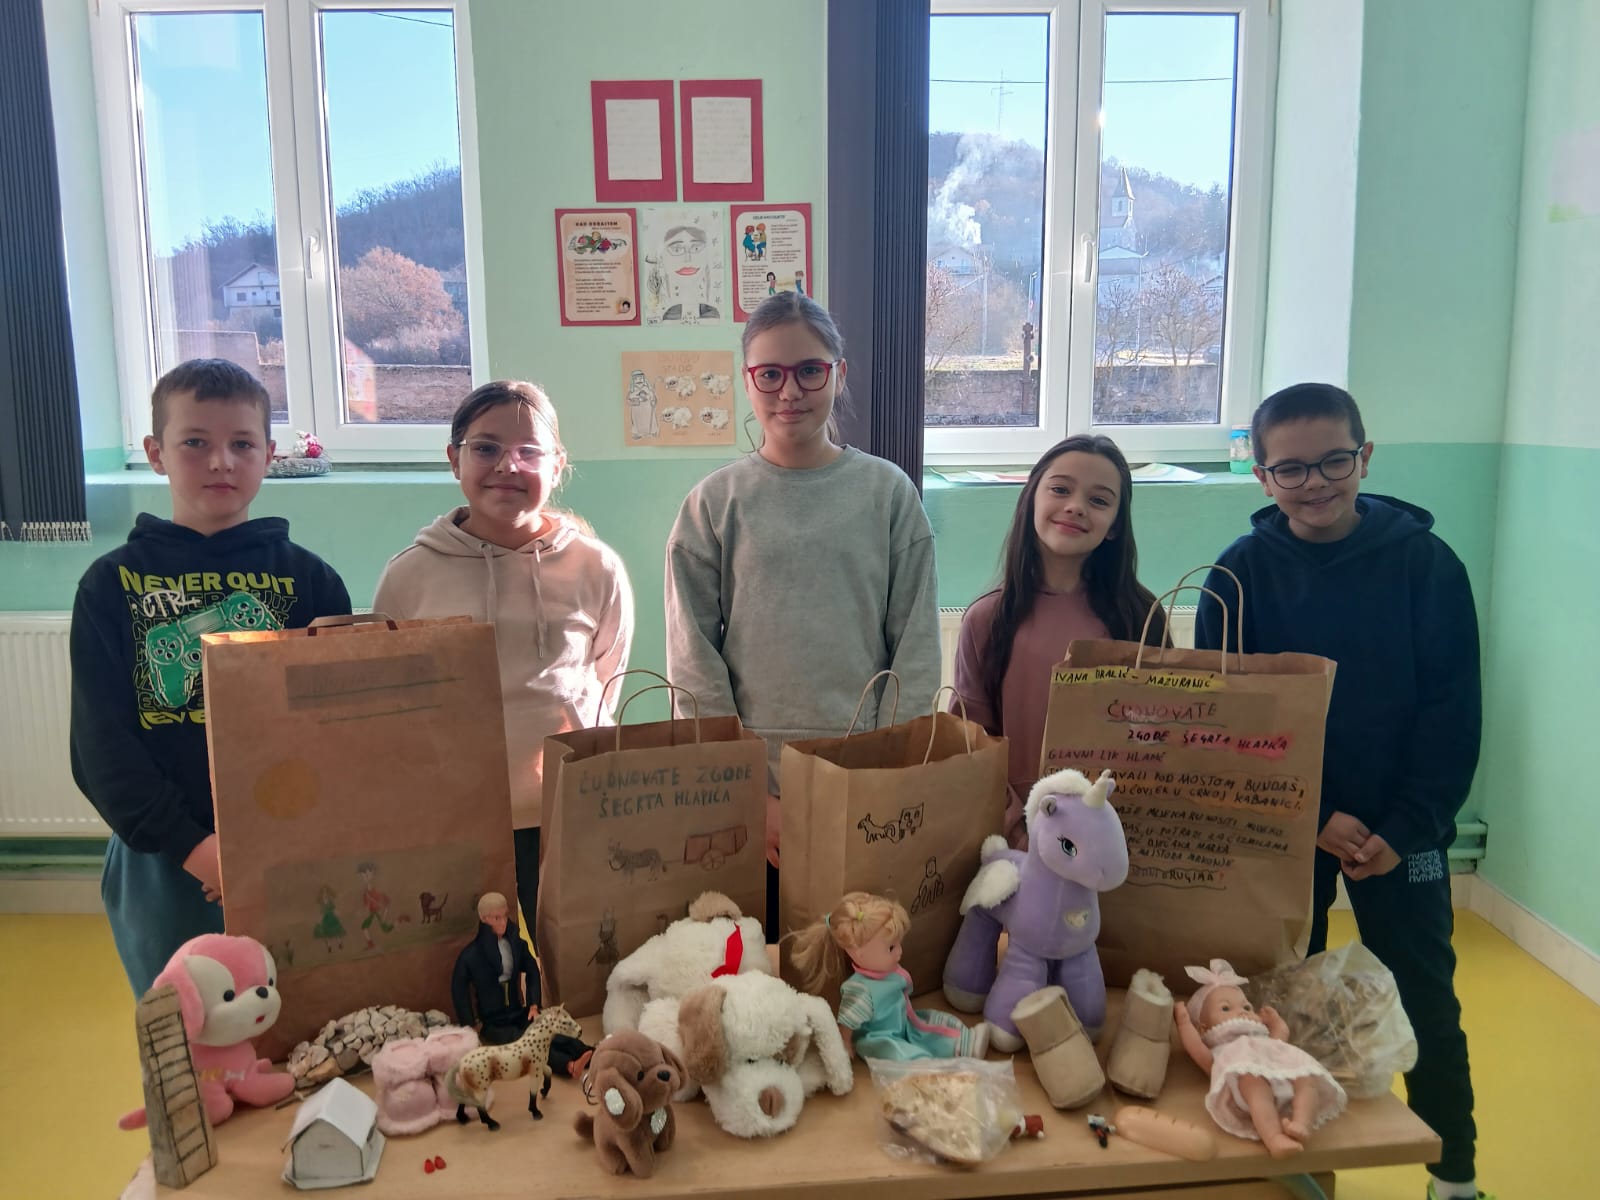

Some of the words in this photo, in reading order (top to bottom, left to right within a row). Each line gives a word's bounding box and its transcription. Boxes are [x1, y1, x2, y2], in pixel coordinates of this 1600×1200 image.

[119, 565, 223, 595] NEVER
[226, 572, 295, 595] QUIT
[1055, 671, 1088, 684] IVANA
[1048, 749, 1094, 761] GLAVNI
[696, 764, 752, 784] ZGODE
[1154, 771, 1174, 783] POD
[1177, 773, 1235, 790] MOSTOM
[1173, 788, 1181, 796] U
[599, 792, 664, 818] ŠEGRTA
